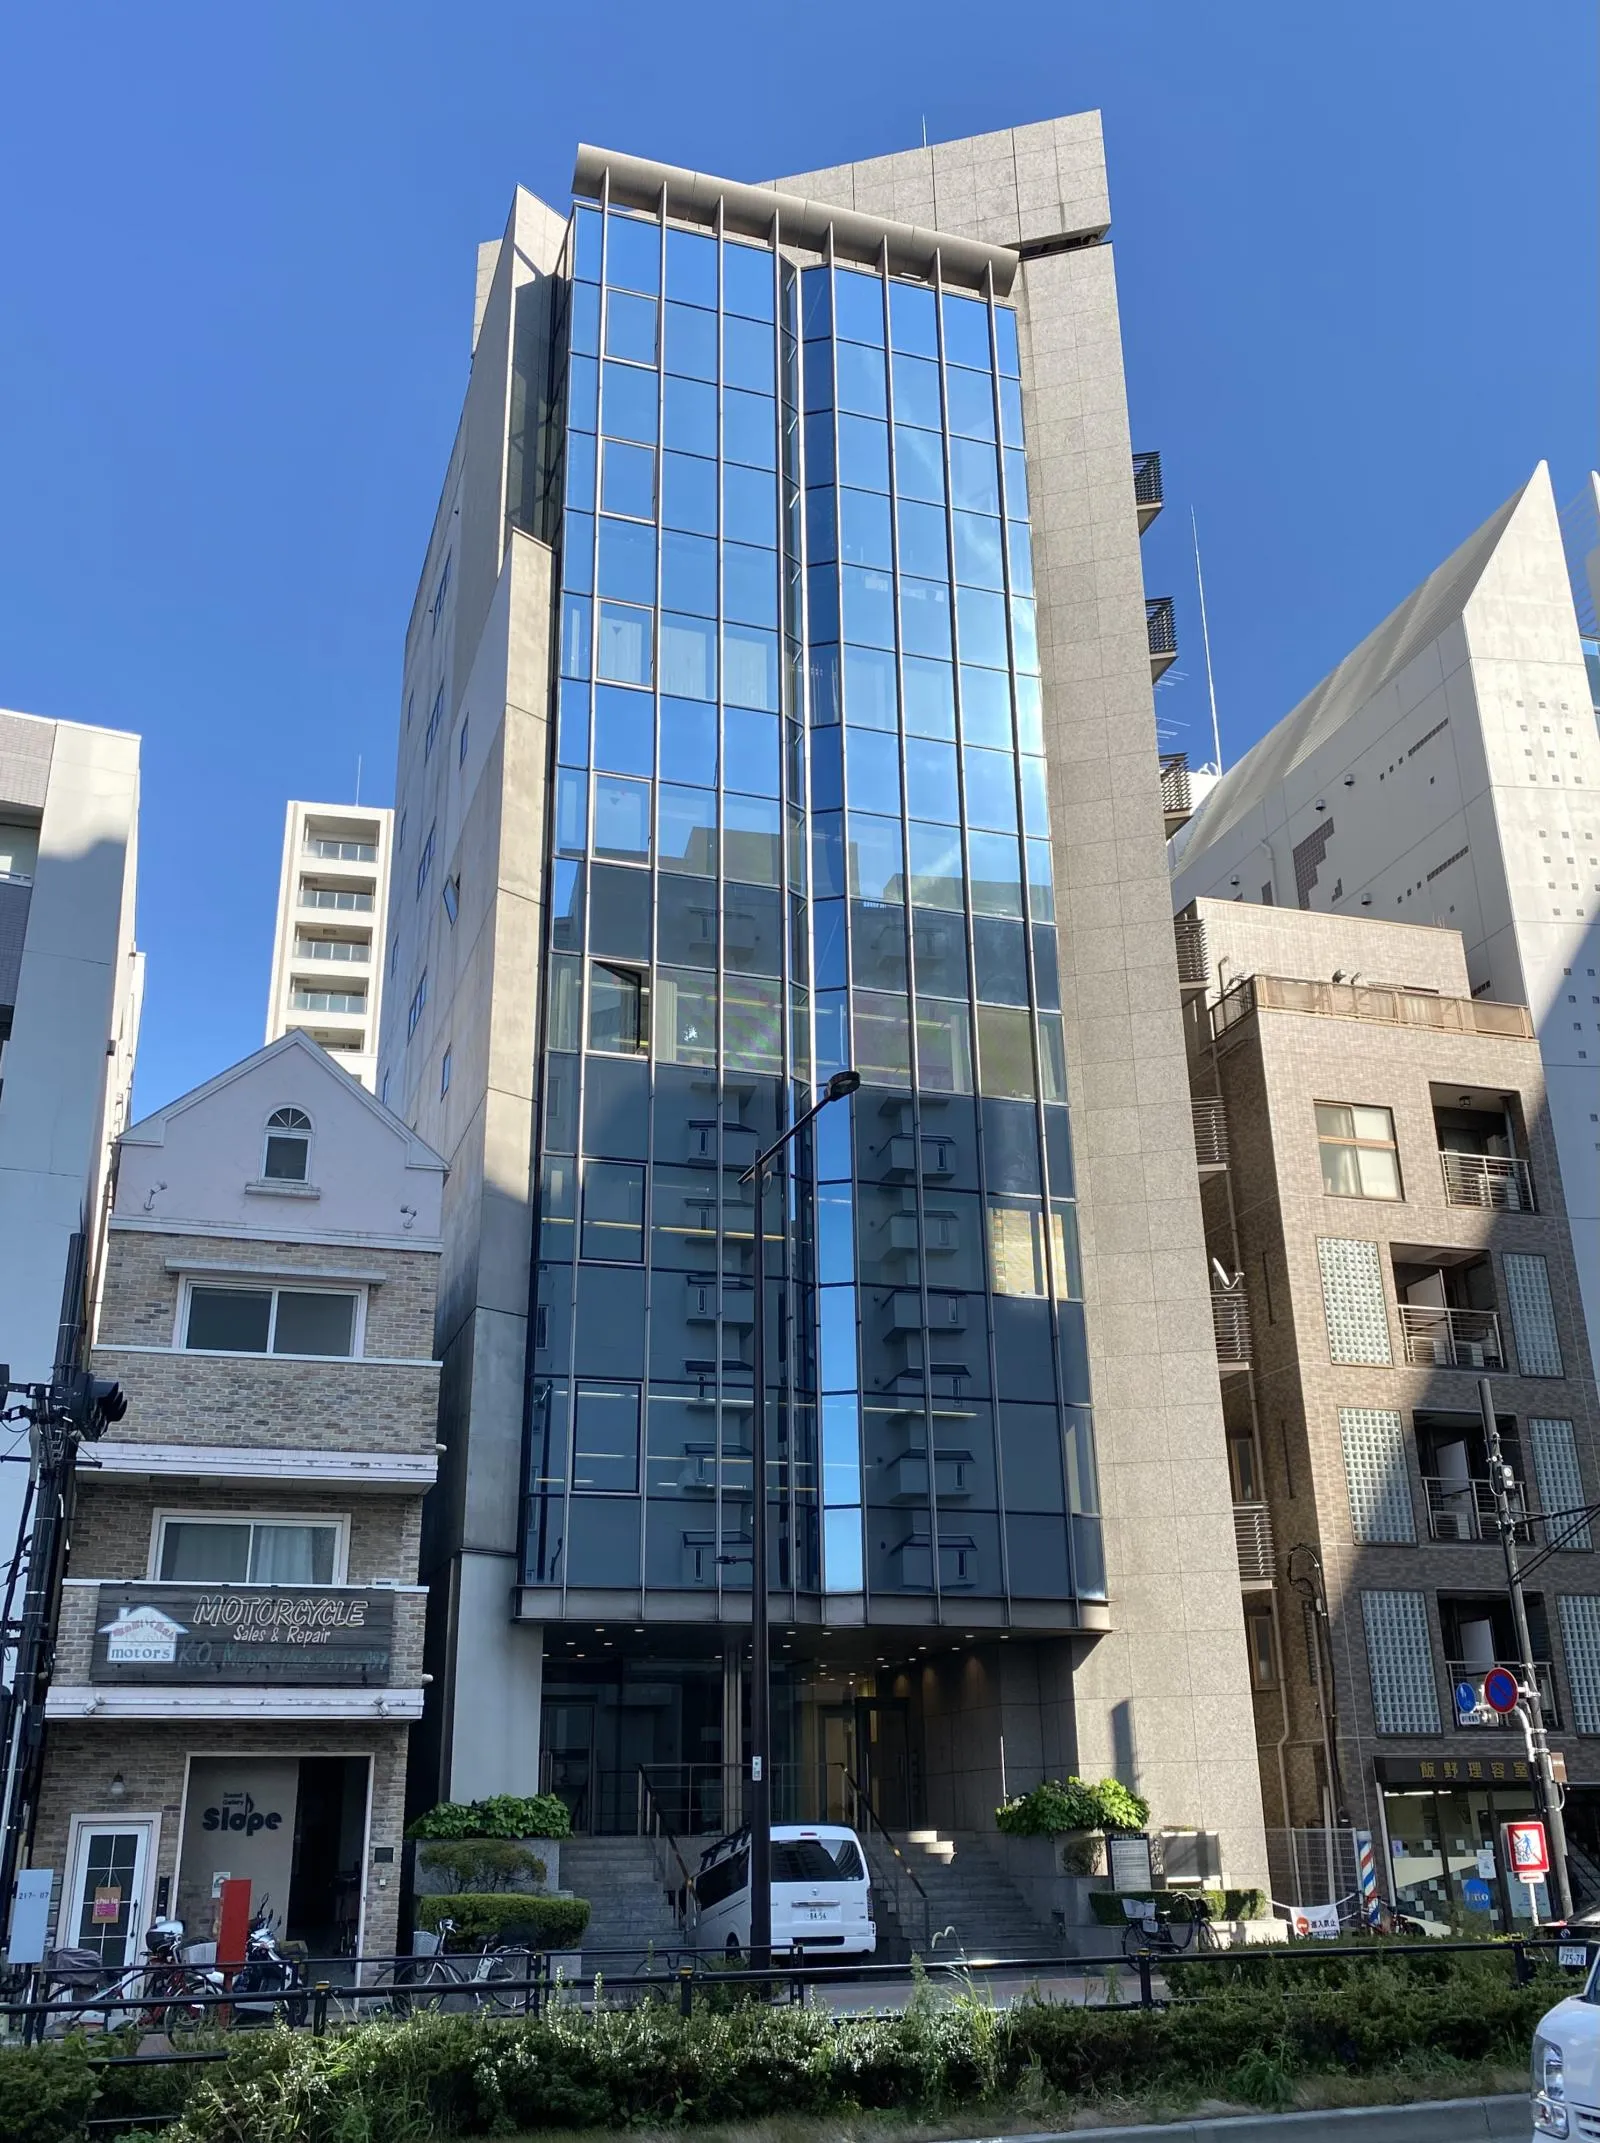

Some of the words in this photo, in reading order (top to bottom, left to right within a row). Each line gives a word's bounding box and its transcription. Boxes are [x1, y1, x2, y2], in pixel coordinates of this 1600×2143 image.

[193, 1595, 368, 1627] MOTORCYCLE
[233, 1625, 264, 1642] Sales
[270, 1627, 279, 1642] &
[286, 1626, 330, 1648] Repair
[111, 1648, 171, 1659] motors
[1420, 1761, 1529, 1778] 飯野理容室
[202, 1807, 282, 1836] Slope
